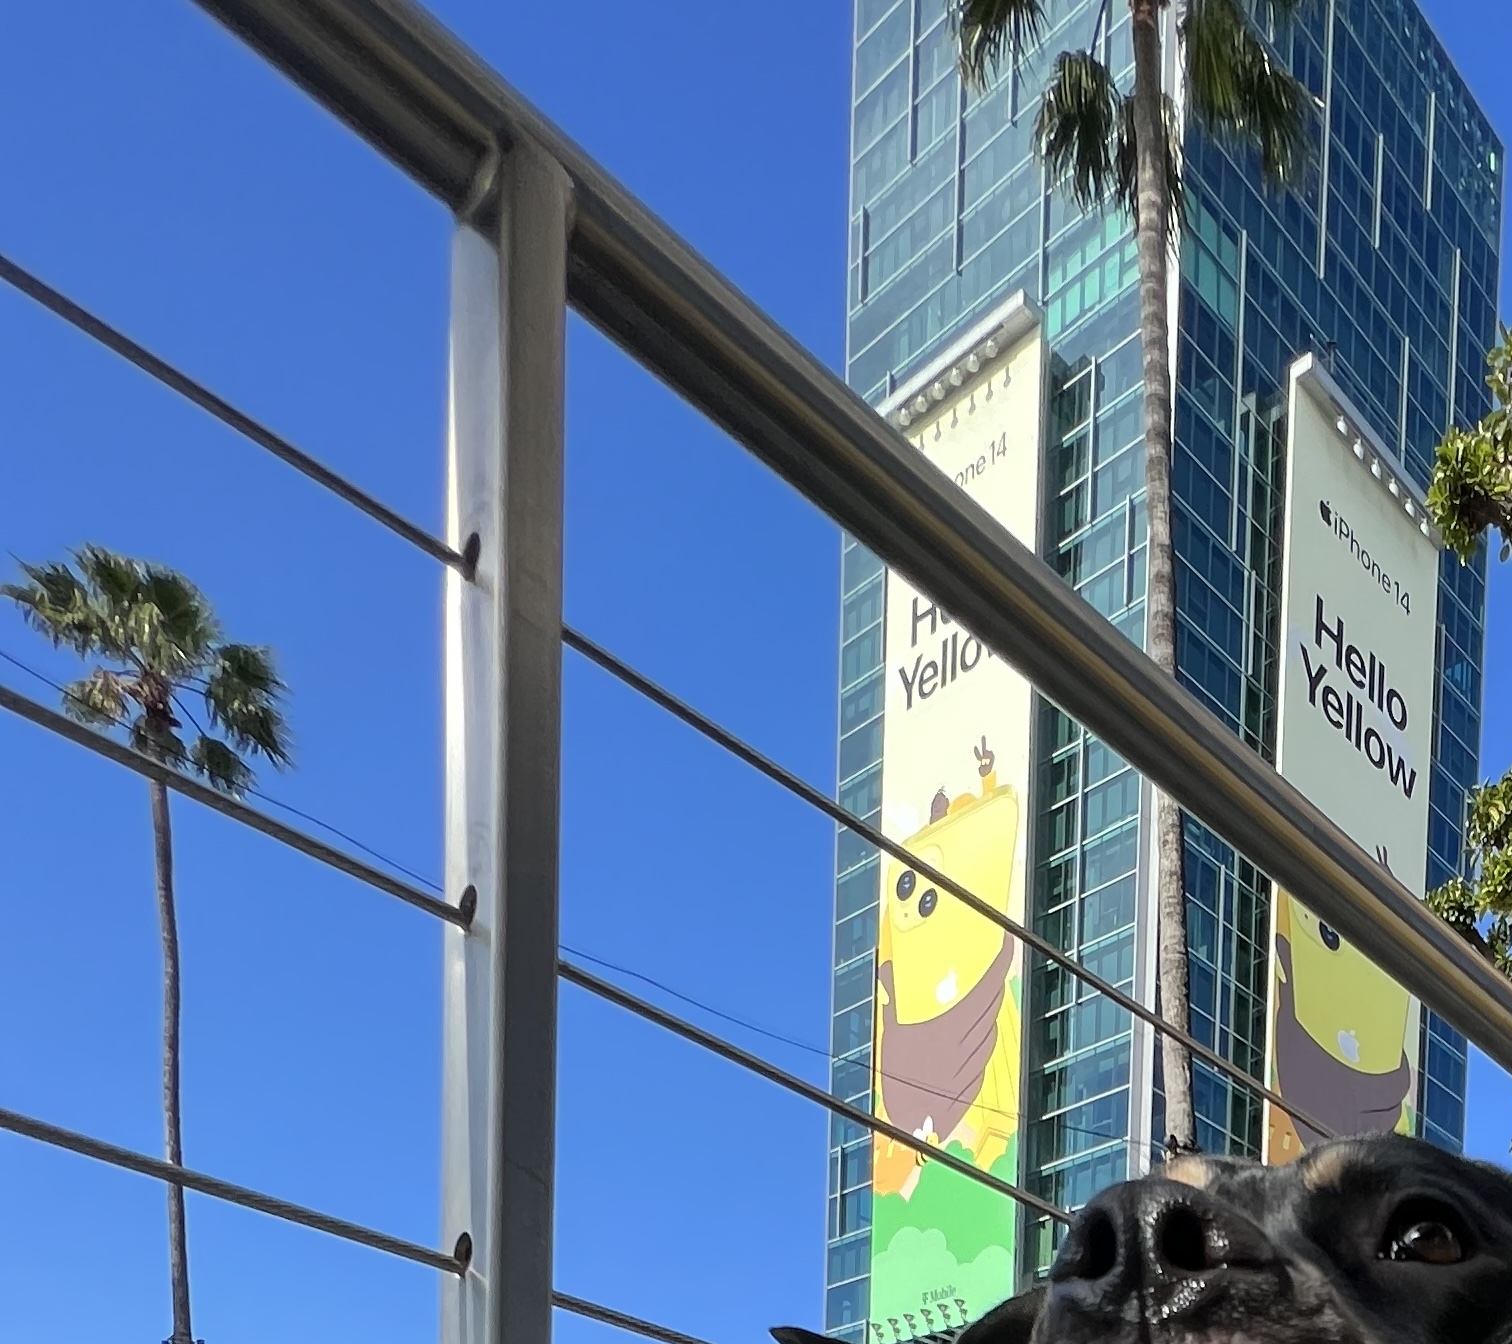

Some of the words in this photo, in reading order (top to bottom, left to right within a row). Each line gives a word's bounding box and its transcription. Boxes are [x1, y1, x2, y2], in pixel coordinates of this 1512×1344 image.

[953, 454, 986, 488] one
[990, 432, 1007, 466] 14
[1333, 511, 1391, 594] iPhone
[1393, 581, 1411, 616] 14
[898, 632, 996, 711] Yello
[1314, 593, 1408, 732] Hello
[1299, 641, 1417, 801] Yellow
